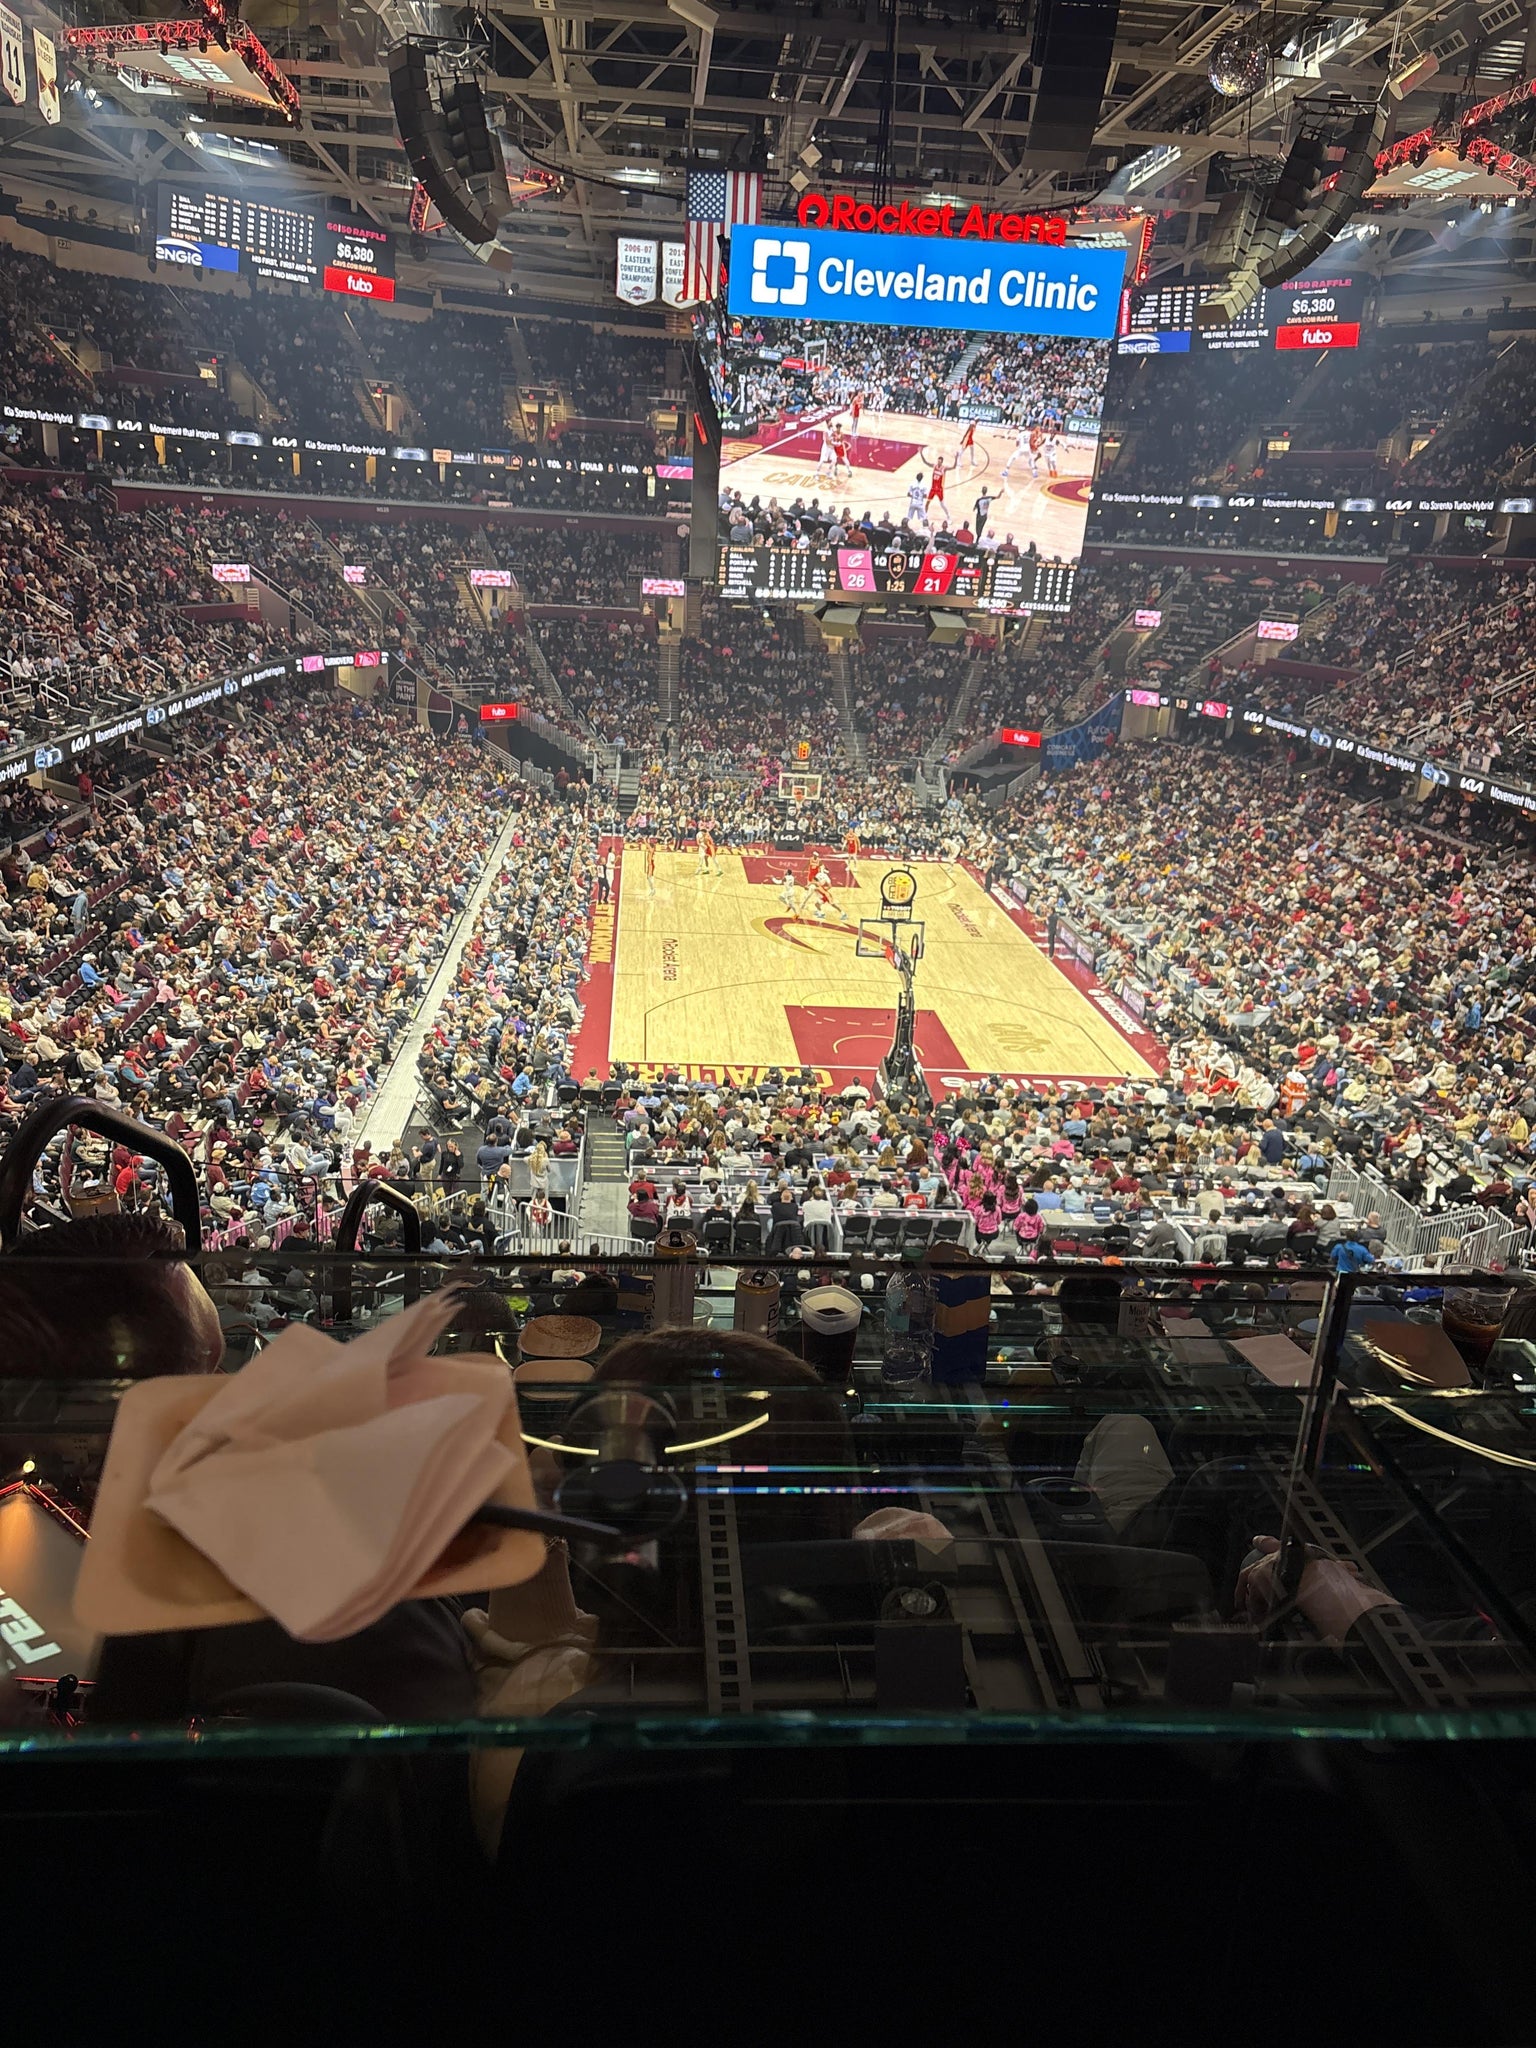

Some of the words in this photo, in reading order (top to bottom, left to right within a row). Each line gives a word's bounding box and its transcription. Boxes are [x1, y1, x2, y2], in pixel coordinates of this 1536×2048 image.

[5, 39, 21, 87] 11
[831, 195, 955, 236] Rocket
[959, 204, 1066, 246] Arena
[353, 228, 387, 242] RAFFLE
[337, 242, 374, 263] $6,380
[624, 255, 651, 264] EASTERN
[620, 264, 656, 274] CONFERENCE
[669, 259, 684, 267] EAST
[347, 275, 373, 293] fubo
[621, 273, 654, 283] CHAMPIONS
[818, 257, 991, 305] Cleveland
[998, 269, 1098, 312] Clinic
[1311, 278, 1352, 289] RAFFLE
[1292, 297, 1336, 315] $6,380
[1302, 328, 1333, 344] fubo
[4, 405, 15, 417] Kia
[15, 406, 37, 420] Sorento
[149, 423, 182, 436] Movement
[182, 427, 195, 438] that
[195, 429, 220, 440] inspires
[1080, 420, 1101, 430] CAESA
[305, 440, 316, 450] Kia
[316, 440, 342, 452] Sorento
[565, 461, 572, 470] 2
[580, 462, 604, 472] FOULS
[642, 465, 653, 475] 40
[1102, 493, 1114, 502] Kia
[1114, 493, 1140, 503] Sorento
[1262, 498, 1297, 508] Movement
[1310, 500, 1335, 510] inspires
[1419, 501, 1430, 510] Kia
[1430, 501, 1453, 511] Sorento
[908, 555, 920, 568] 18
[847, 574, 866, 588] 26
[886, 580, 905, 592] 1:25
[923, 577, 941, 592] 21
[788, 589, 825, 599] RAFFLE
[95, 726, 118, 743] Movement
[118, 720, 128, 733] that
[128, 716, 143, 732] inspires
[1013, 732, 1030, 744] fubo
[1490, 785, 1524, 806] Movement
[1524, 796, 1536, 811] tha
